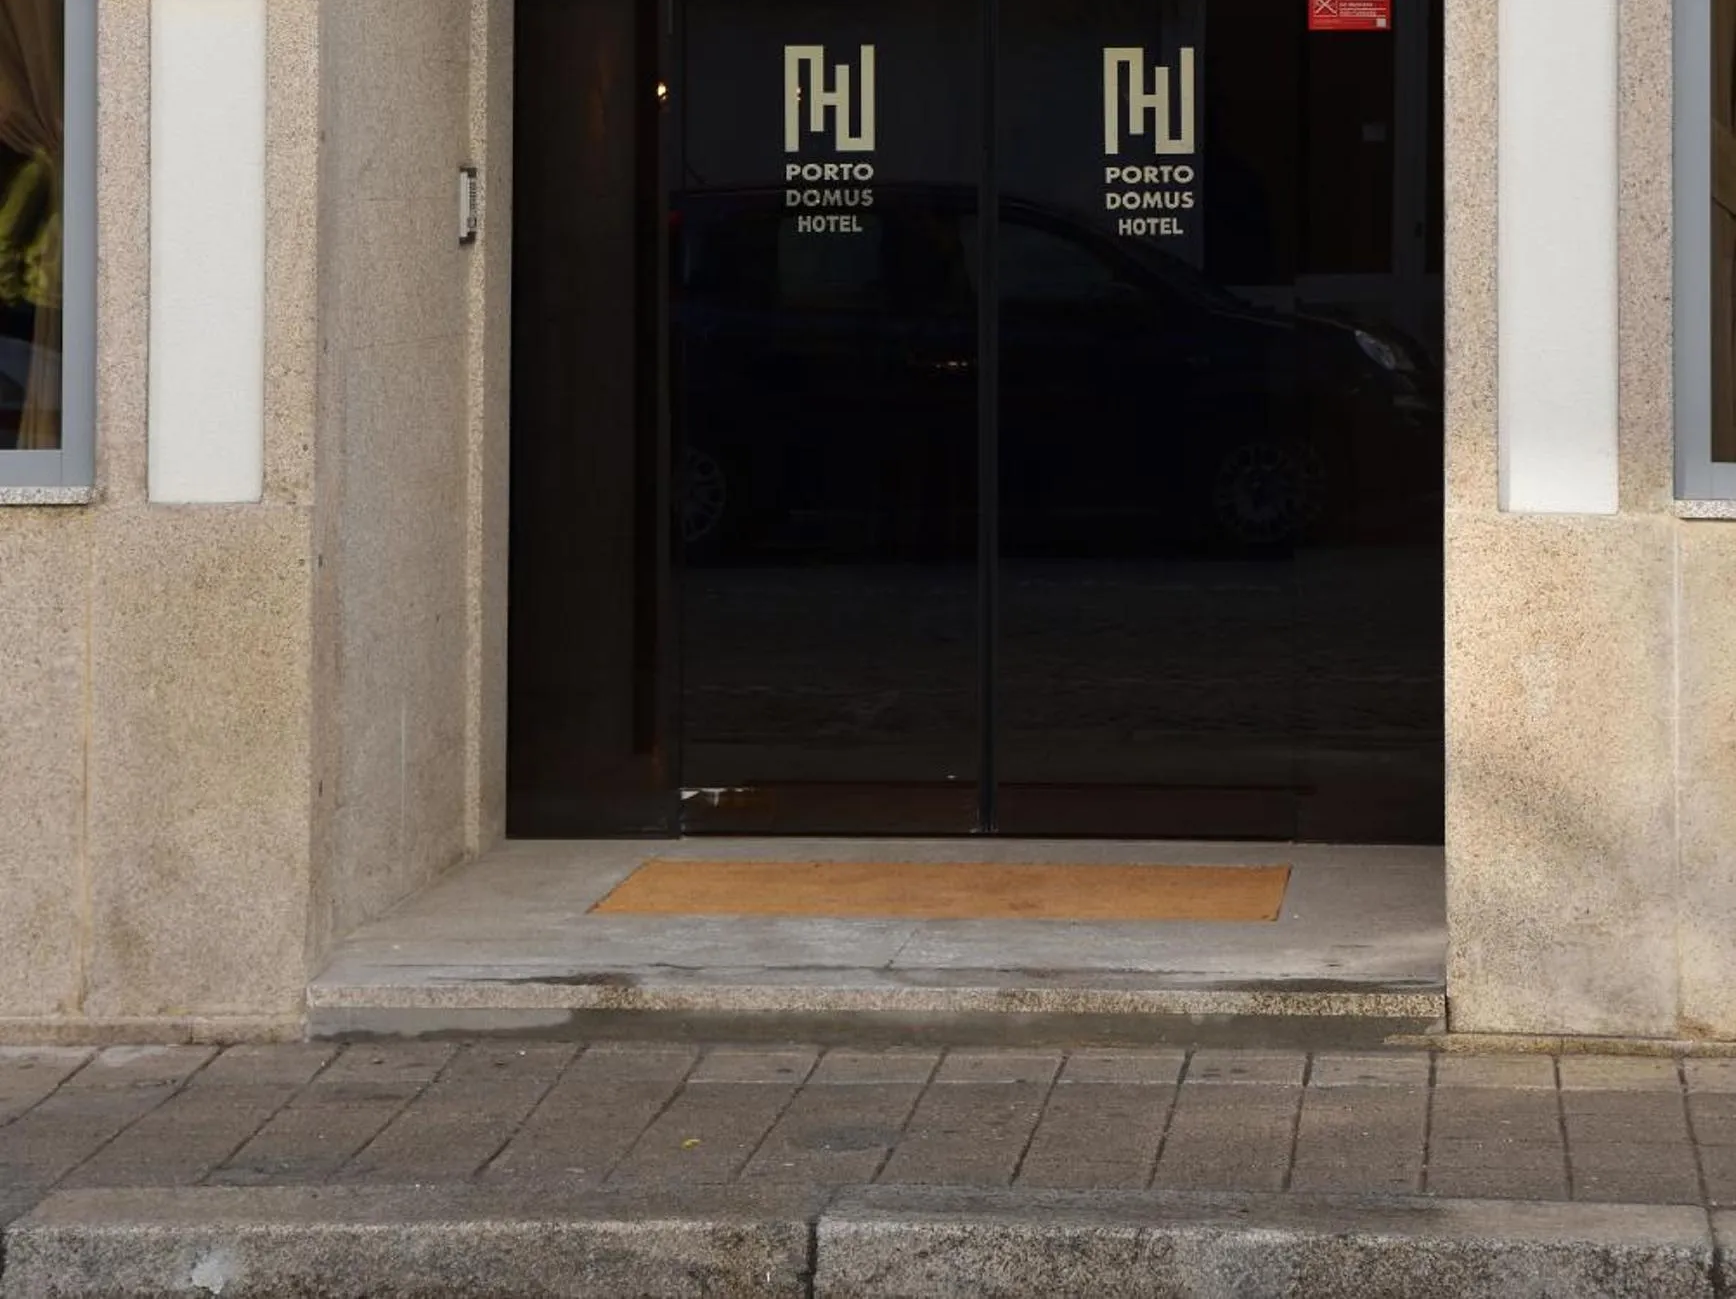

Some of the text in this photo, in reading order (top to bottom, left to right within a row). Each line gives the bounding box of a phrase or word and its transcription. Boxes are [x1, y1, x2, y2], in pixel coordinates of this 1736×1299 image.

[785, 163, 874, 181] PORTO
[1105, 165, 1195, 184] PORTO
[785, 189, 874, 207] DOMUS
[1105, 191, 1195, 210] DOMUS
[798, 215, 863, 233] HOTEL
[1118, 217, 1184, 236] HOTEL
